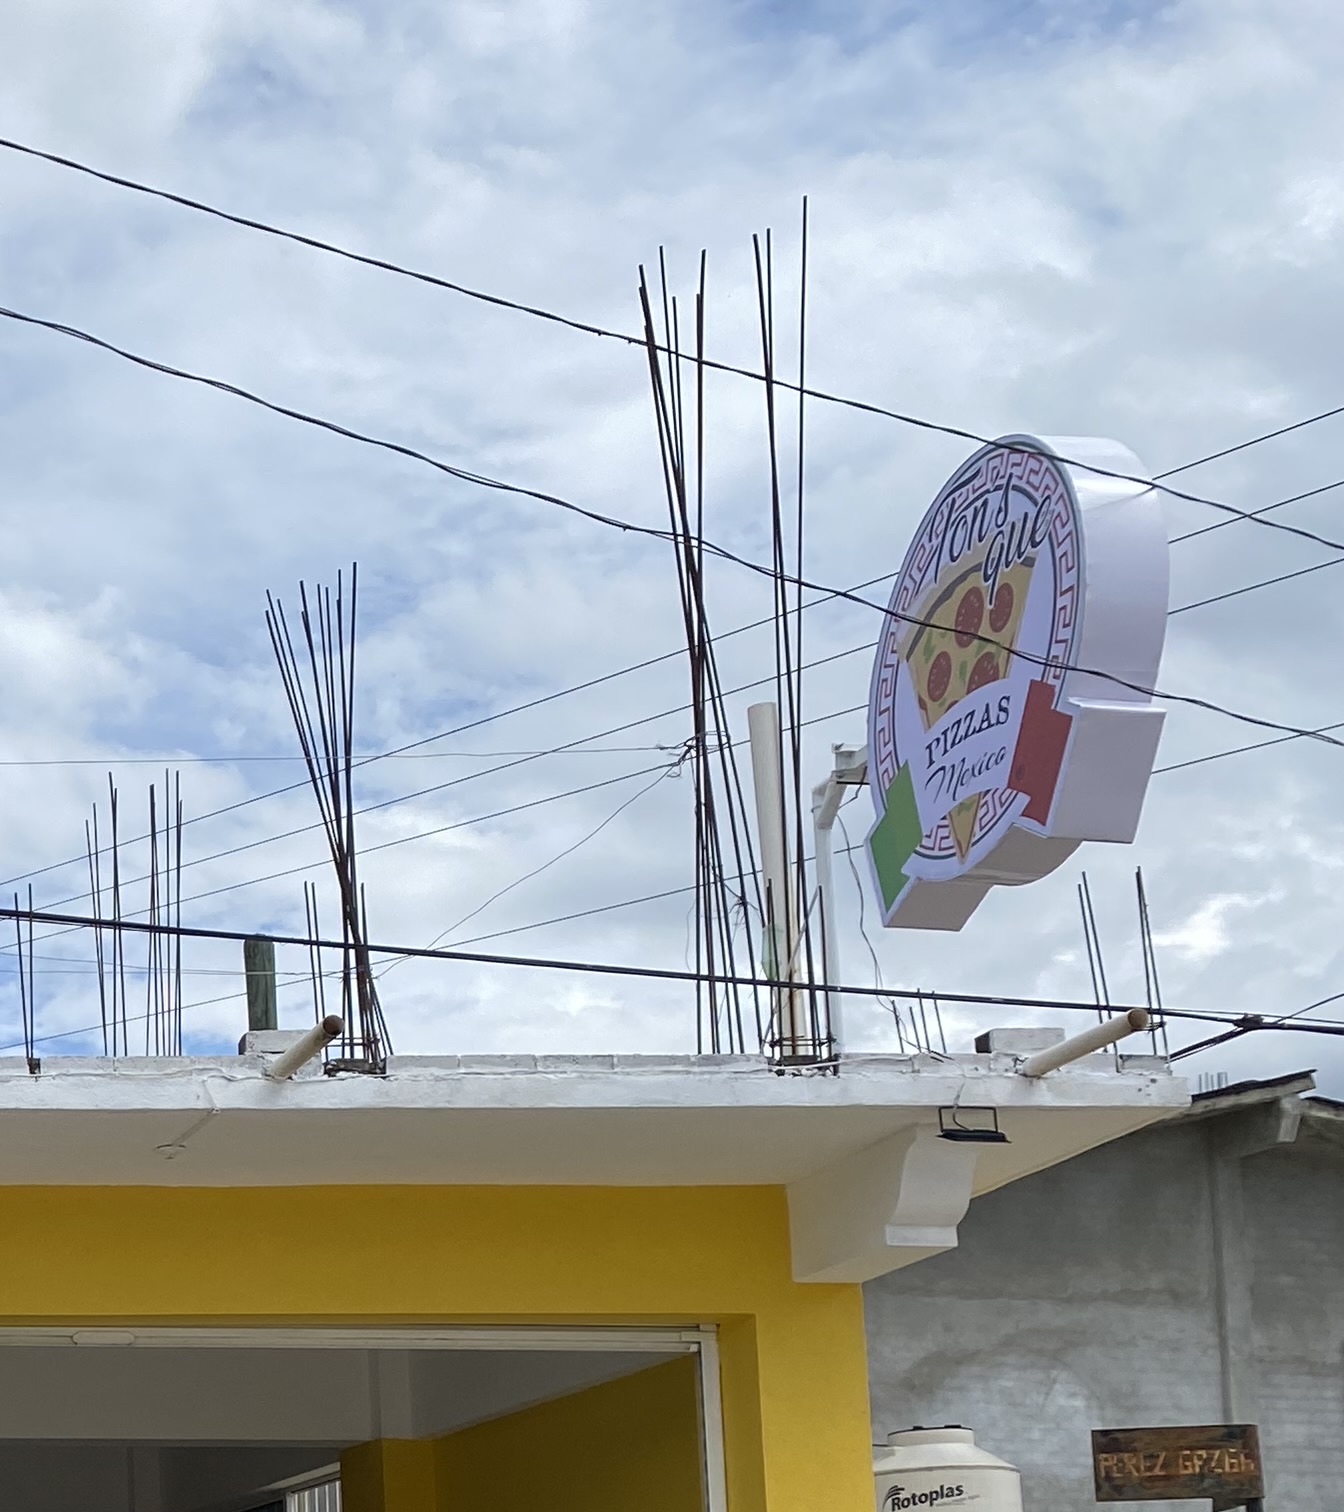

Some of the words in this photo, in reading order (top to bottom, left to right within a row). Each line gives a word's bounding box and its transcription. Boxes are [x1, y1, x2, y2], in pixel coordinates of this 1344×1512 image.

[983, 494, 1051, 605] que
[925, 695, 1011, 770] PIZZAS
[925, 746, 1006, 804] Mexico
[891, 1484, 964, 1512] Rotoplas
